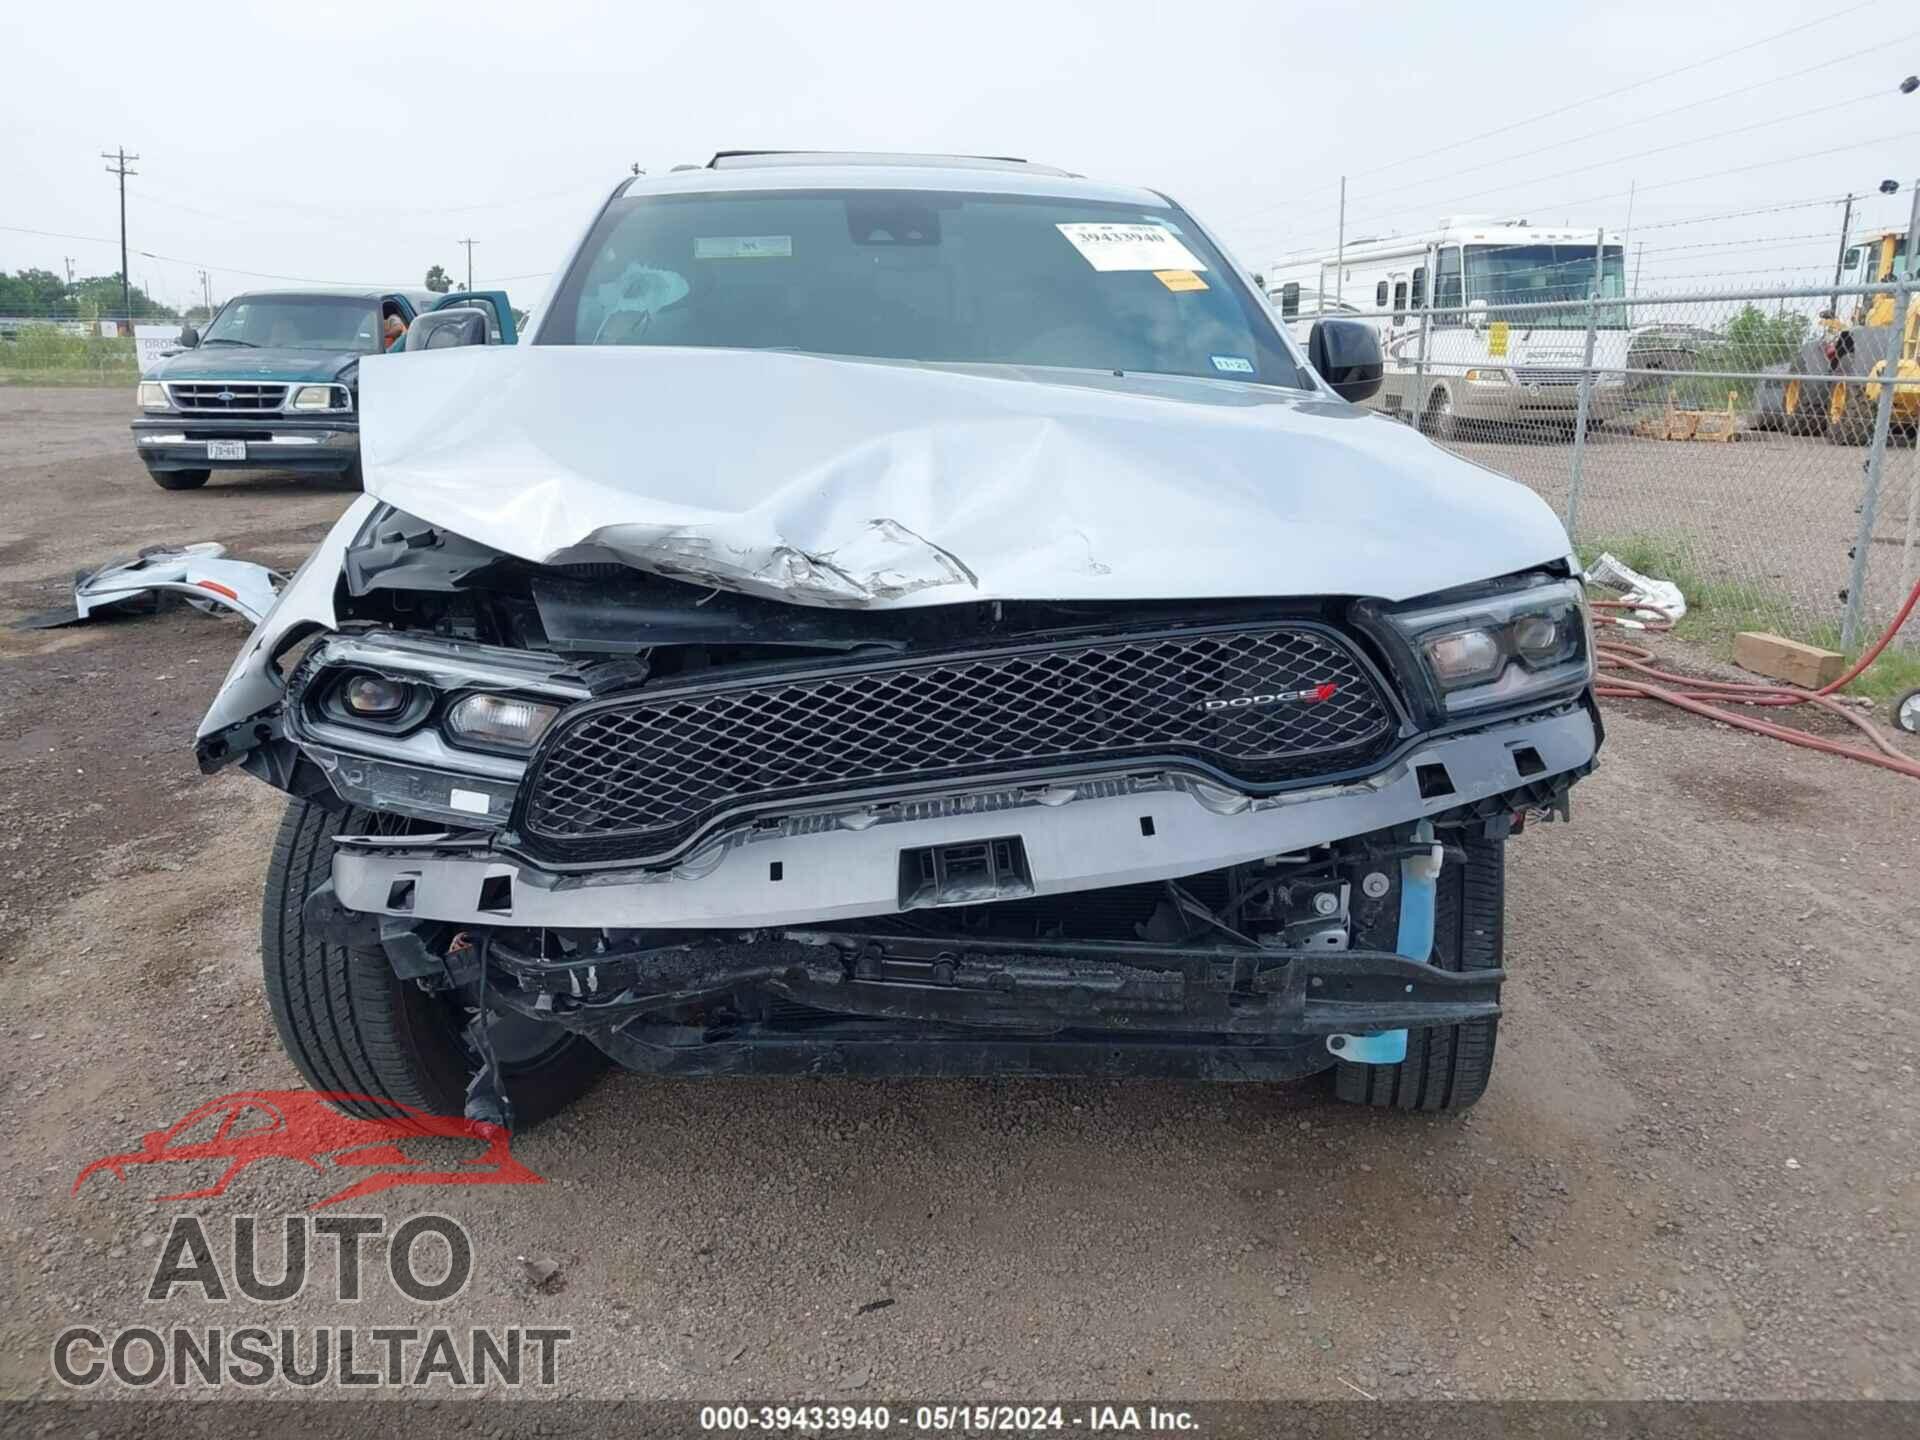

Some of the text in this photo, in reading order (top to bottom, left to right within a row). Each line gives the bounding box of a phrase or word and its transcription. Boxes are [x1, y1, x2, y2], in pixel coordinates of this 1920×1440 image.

[1078, 231, 1166, 244] 39433940
[1526, 350, 1585, 359] SCOTTSDAL
[1205, 691, 1321, 711] DODGE
